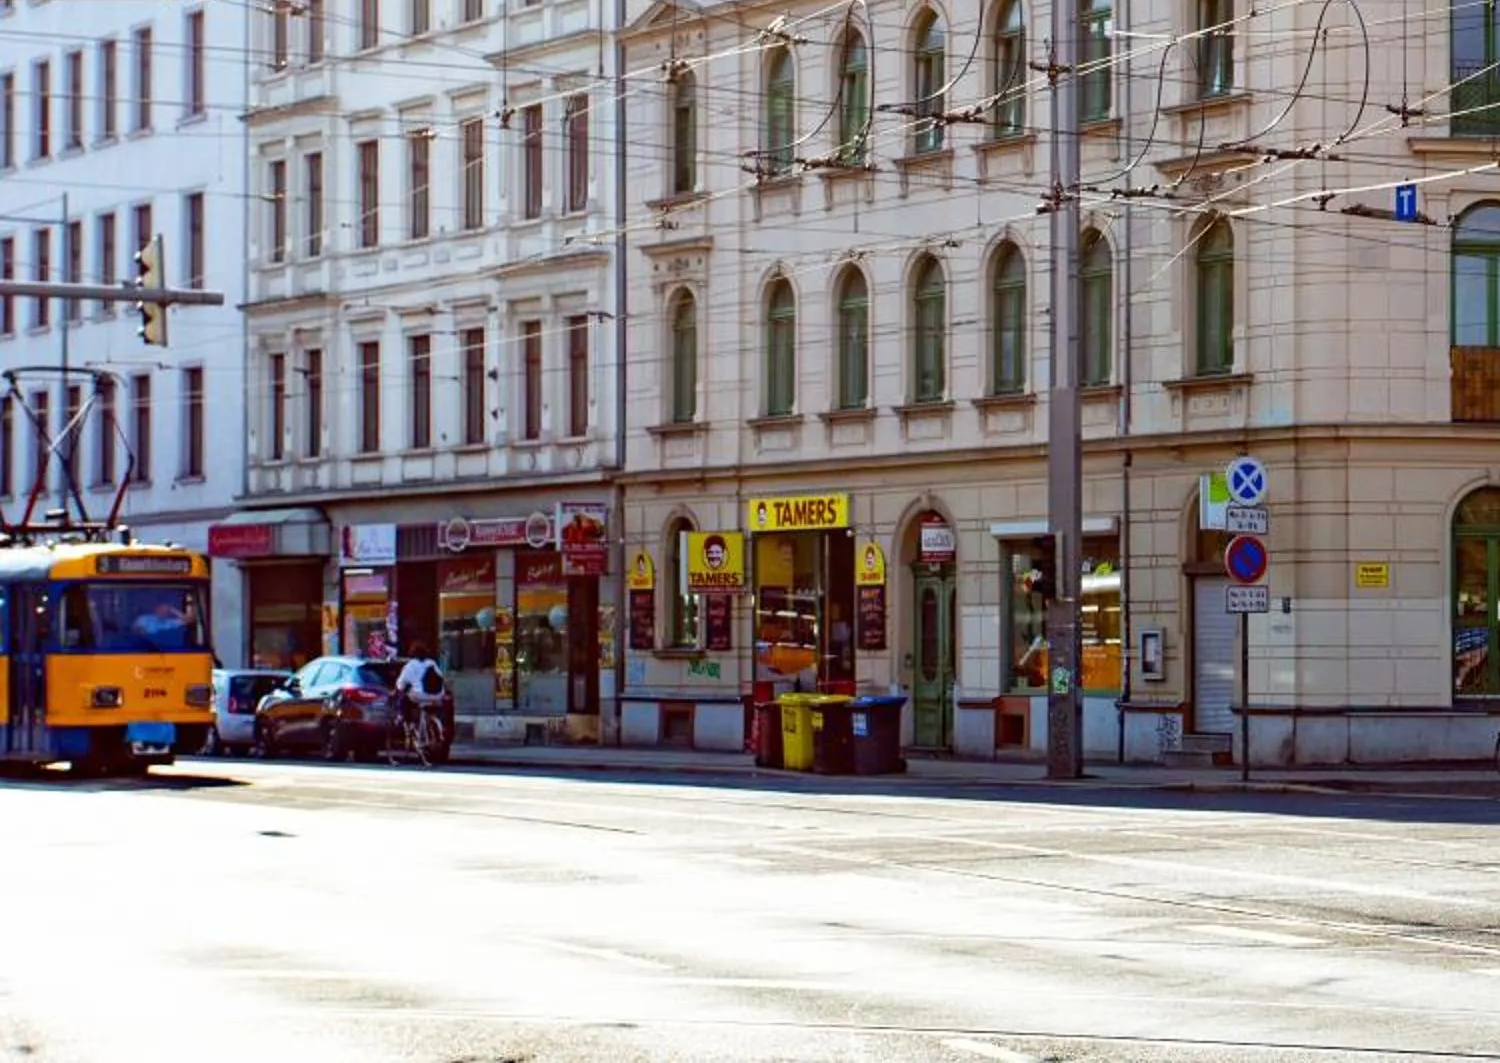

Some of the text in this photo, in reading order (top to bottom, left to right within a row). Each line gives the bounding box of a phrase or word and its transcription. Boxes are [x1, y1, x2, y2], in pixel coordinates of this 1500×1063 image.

[1400, 190, 1412, 215] T
[773, 500, 836, 525] TAMERS
[690, 572, 739, 585] TAMERS
